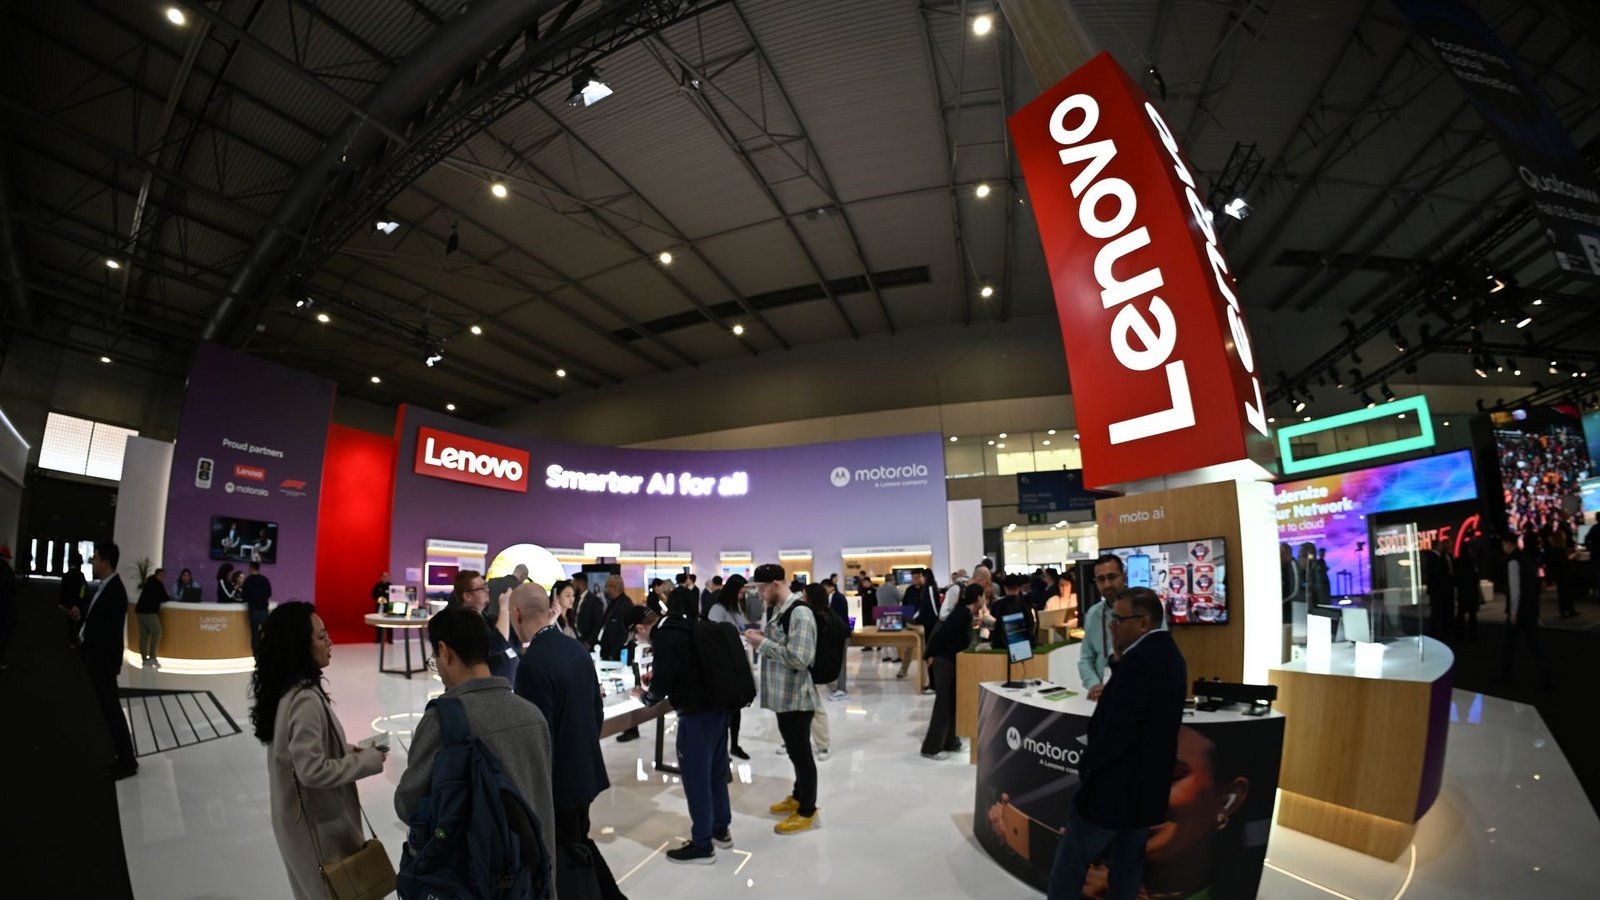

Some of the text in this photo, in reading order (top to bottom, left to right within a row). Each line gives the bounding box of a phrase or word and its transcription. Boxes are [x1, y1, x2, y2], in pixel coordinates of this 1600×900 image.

[1048, 92, 1196, 446] Lenovo
[1144, 101, 1268, 437] Lenovo
[222, 438, 284, 458] Proud partners
[424, 437, 523, 481] Lenovo
[235, 466, 264, 478] Lenovo
[546, 464, 748, 496] Smarter AI for all
[855, 463, 928, 481] motorola
[235, 484, 269, 497] motorola
[901, 479, 928, 487] company
[1119, 506, 1165, 523] moto ai
[1275, 497, 1353, 521] ur Network
[1288, 523, 1297, 532] to
[1299, 518, 1325, 531] cloud
[1024, 737, 1083, 764] motoro
[1045, 761, 1065, 772] Lenovo
